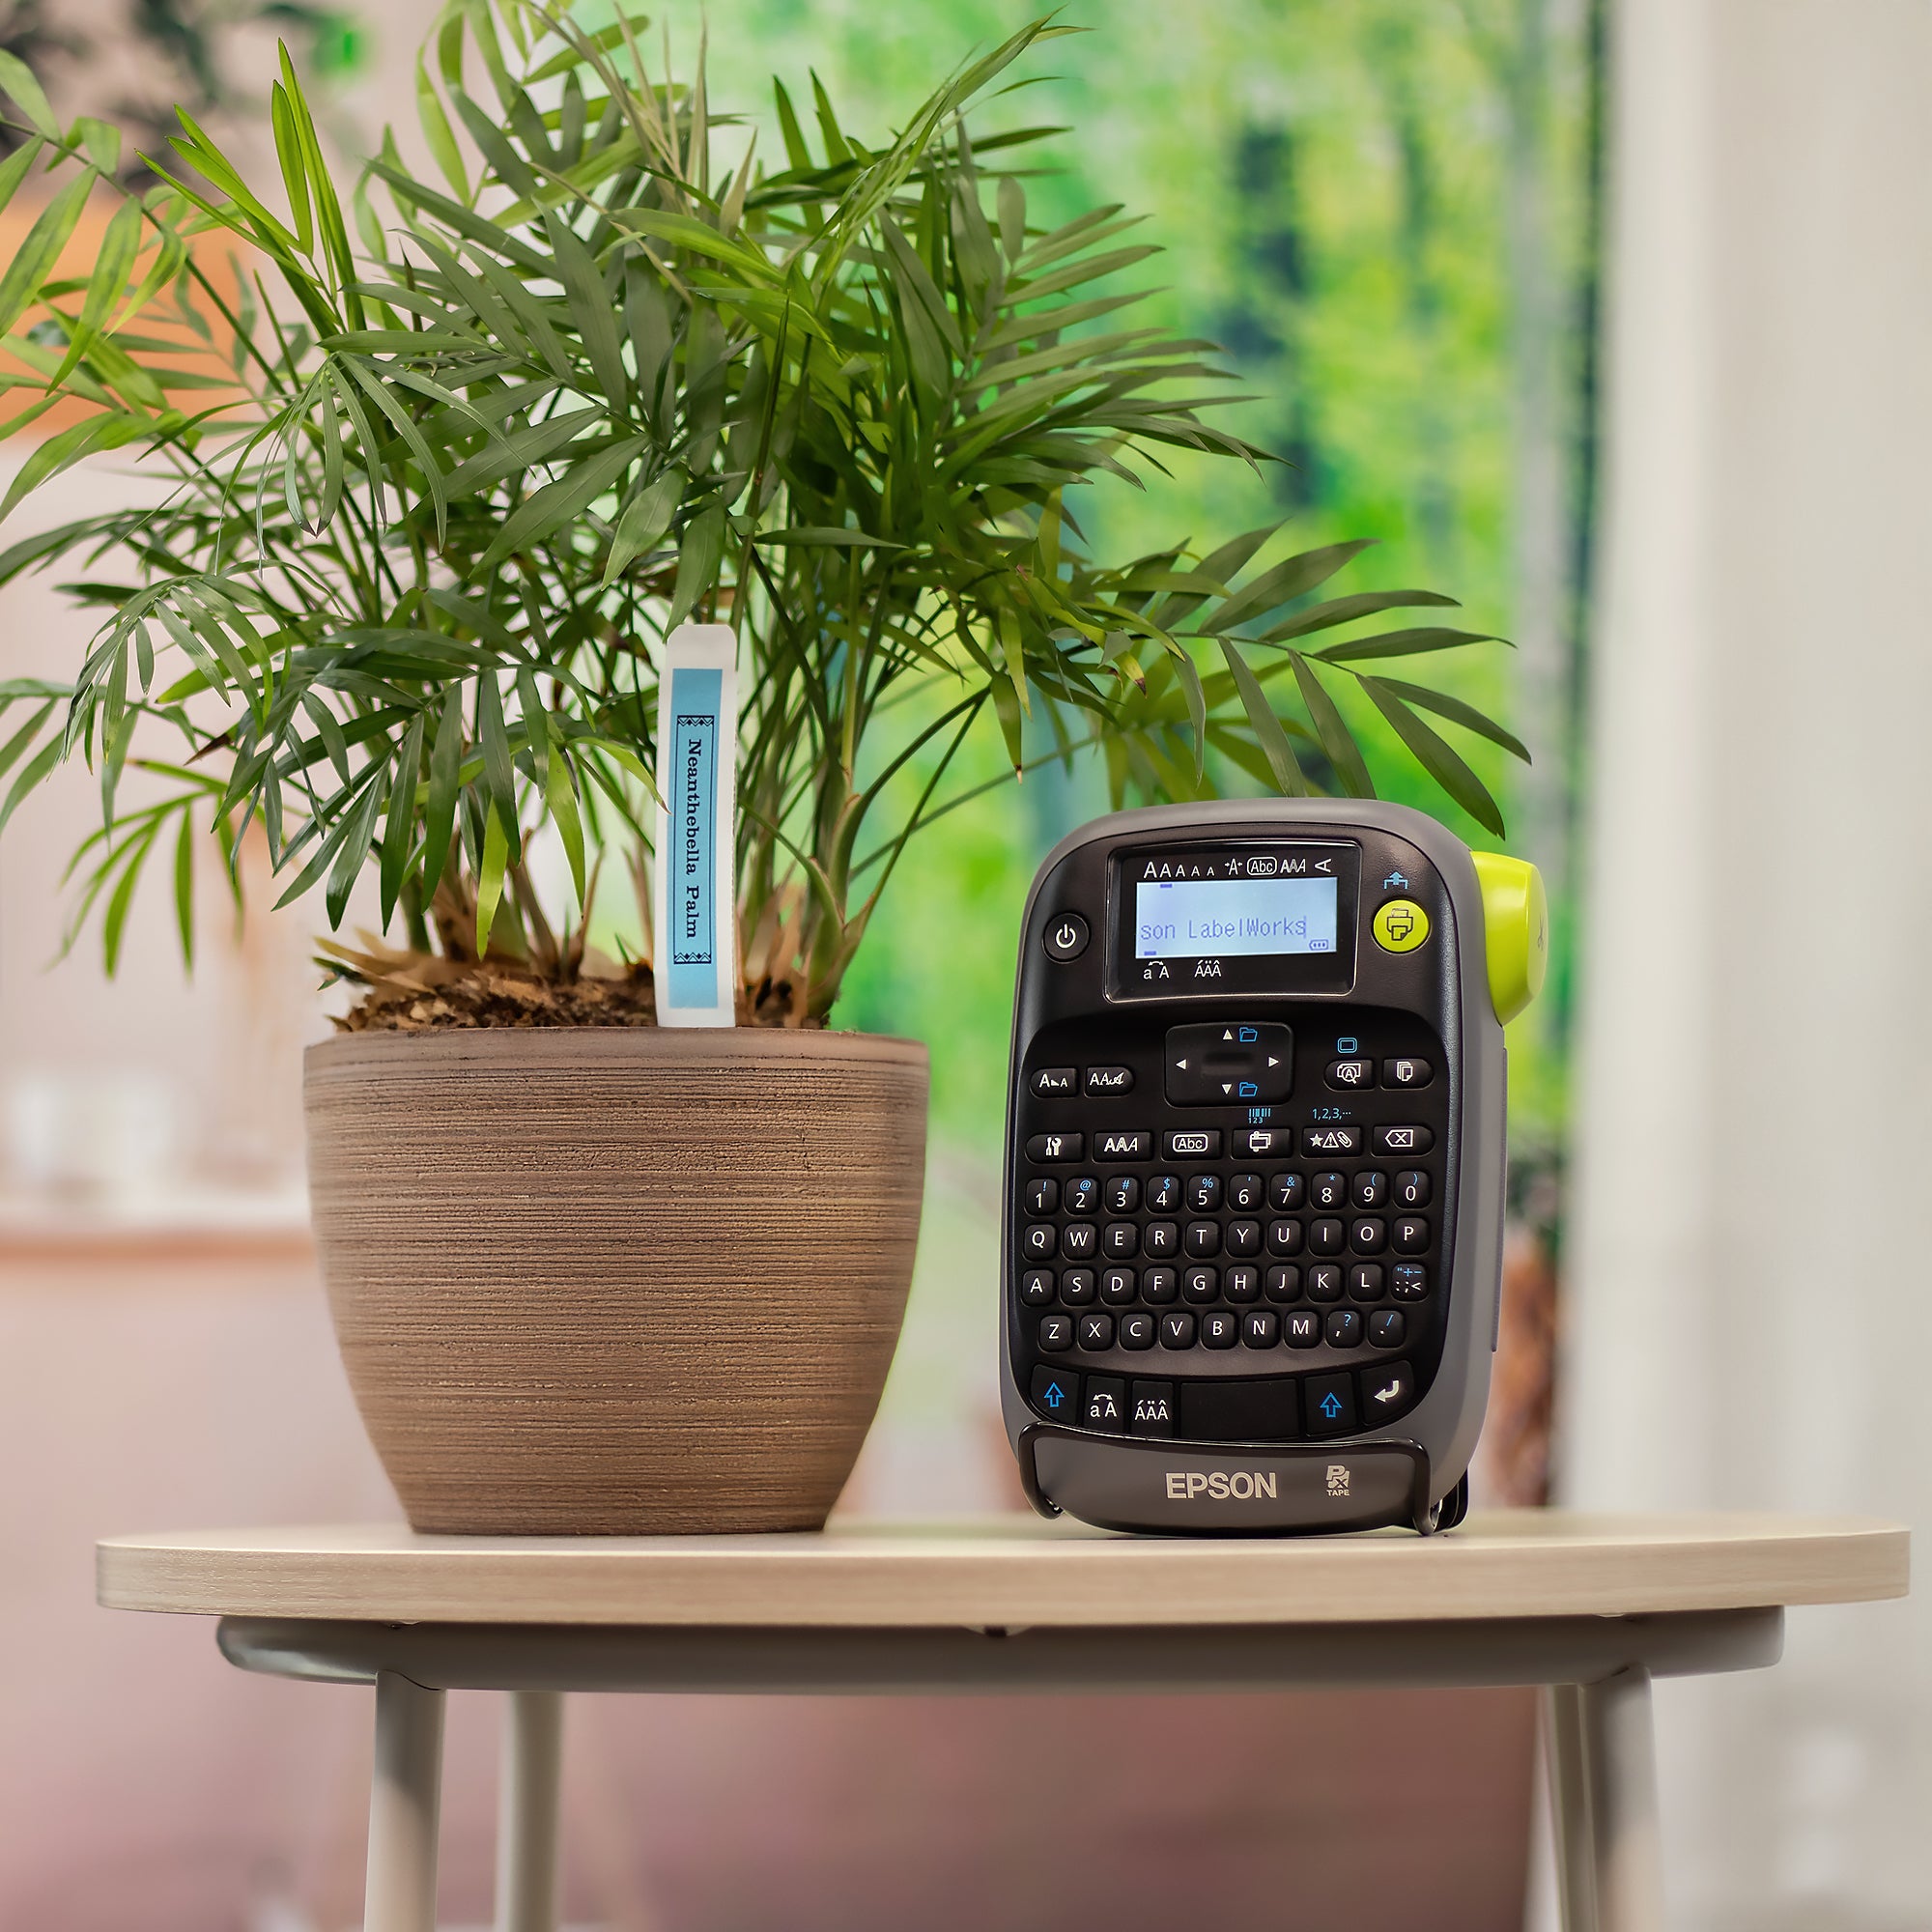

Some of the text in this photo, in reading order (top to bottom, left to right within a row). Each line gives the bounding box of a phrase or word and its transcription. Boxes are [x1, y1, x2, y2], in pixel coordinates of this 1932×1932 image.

[686, 739, 701, 938] Neanthebella Palm
[1144, 862, 1157, 878] A
[1160, 864, 1171, 877] A
[1176, 865, 1185, 877] A
[1191, 866, 1200, 876] A
[1207, 867, 1214, 875] A
[1251, 861, 1273, 873] Abc
[1141, 918, 1305, 940] son LabelWorks
[1104, 1137, 1203, 1151] AAA Abc
[1037, 1186, 1416, 1208] 1 2 3 4 5 6 7 8 9 0
[1033, 1227, 1413, 1248] Q W E R T Y U I O P
[1031, 1273, 1370, 1293] A S D F G H J K L
[1049, 1320, 1309, 1339] Z X C V B N M
[1166, 1471, 1277, 1499] EPSON
